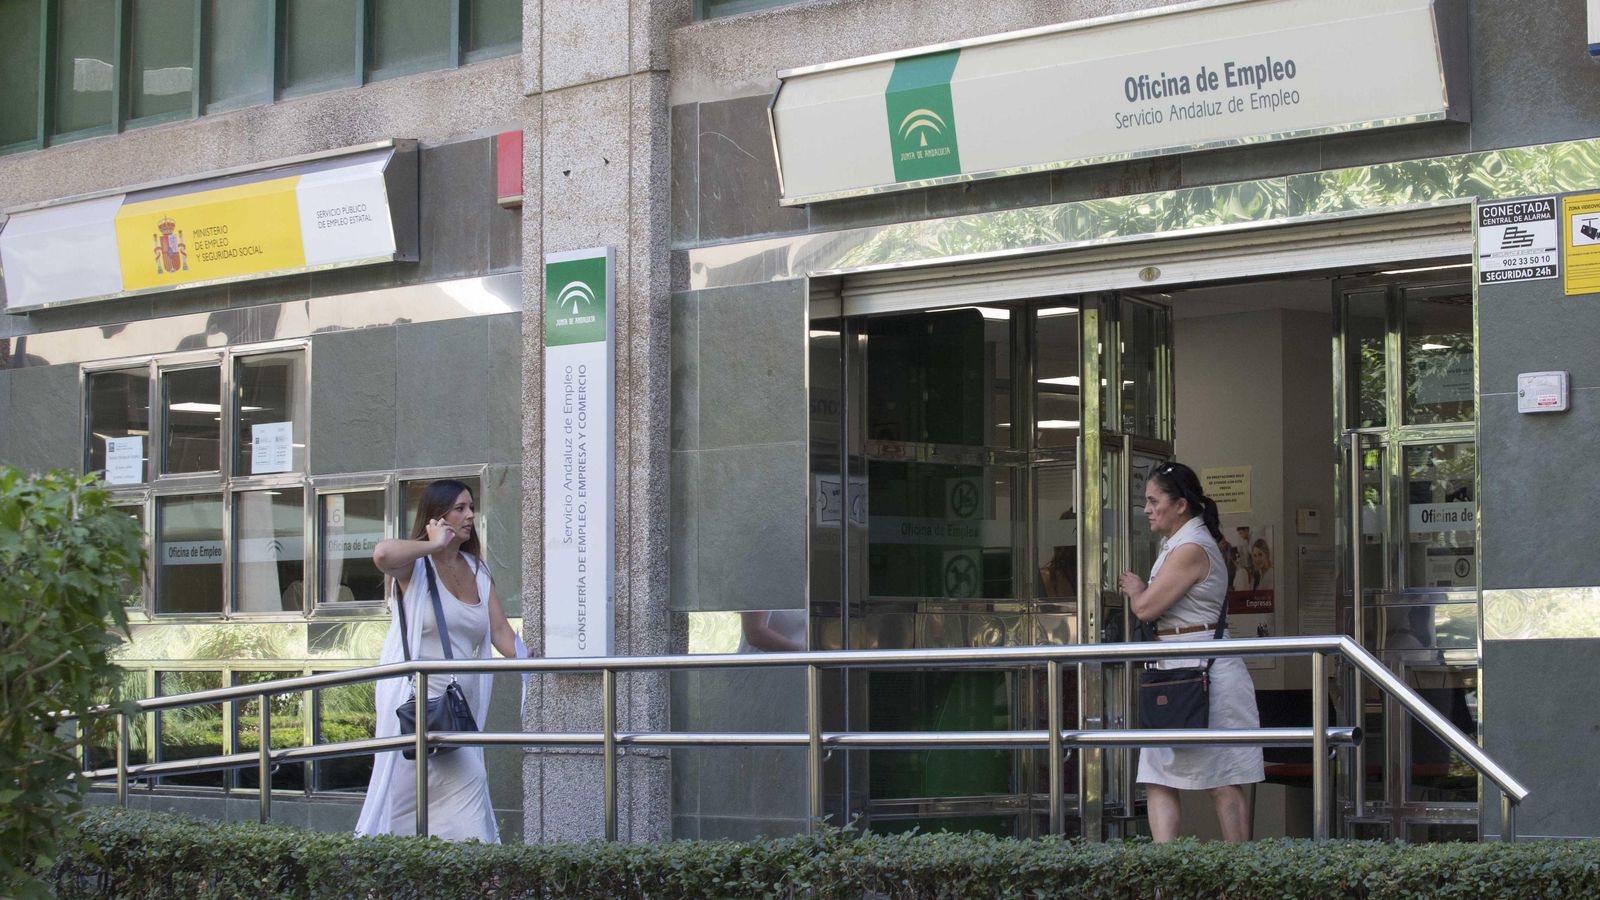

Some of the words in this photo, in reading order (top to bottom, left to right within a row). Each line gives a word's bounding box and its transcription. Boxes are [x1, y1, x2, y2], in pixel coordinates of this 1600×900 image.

[1124, 70, 1190, 103] Oficina
[1195, 64, 1220, 94] de
[1224, 56, 1297, 90] Empleo
[1115, 106, 1163, 130] Servicio
[1170, 100, 1222, 122] Andaluz
[1228, 96, 1244, 114] de
[1252, 89, 1300, 112] Empleo
[900, 152, 916, 162] JUNTA
[916, 150, 924, 159] DE
[316, 208, 342, 219] SERVICIO
[1482, 201, 1551, 218] CONECTADA
[318, 220, 326, 229] DE
[327, 218, 348, 228] EMPLEO
[350, 214, 372, 224] ESTATAL
[1482, 216, 1512, 226] CENTRAL
[1513, 214, 1524, 222] DE
[1524, 212, 1552, 221] ALARMA
[192, 225, 228, 238] MINISTERIO
[194, 241, 204, 250] DE
[204, 238, 229, 250] EMPLEO
[196, 254, 200, 262] Y
[202, 248, 238, 262] SEGURIDAD
[239, 245, 263, 256] SOCIAL
[1530, 256, 1539, 264] 50
[1486, 269, 1534, 282] SEGURIDAD
[1535, 267, 1552, 277] 24h
[563, 365, 575, 414] Empleo
[578, 364, 587, 430] COMERCIO
[563, 418, 573, 434] de
[578, 432, 587, 443] Y
[563, 438, 573, 491] Andaluz
[578, 444, 587, 498] EMPRESA
[563, 494, 573, 544] Servicio
[1421, 509, 1457, 523] Oficina
[1461, 508, 1473, 522] de
[578, 501, 588, 553] EMPLEO,
[168, 546, 190, 558] Oficina
[190, 545, 198, 558] de
[199, 544, 222, 558] Empleo
[353, 539, 361, 551] de
[578, 556, 587, 573] DE
[1246, 600, 1272, 608] Empresas
[576, 576, 587, 650] CONSEJERÍA
